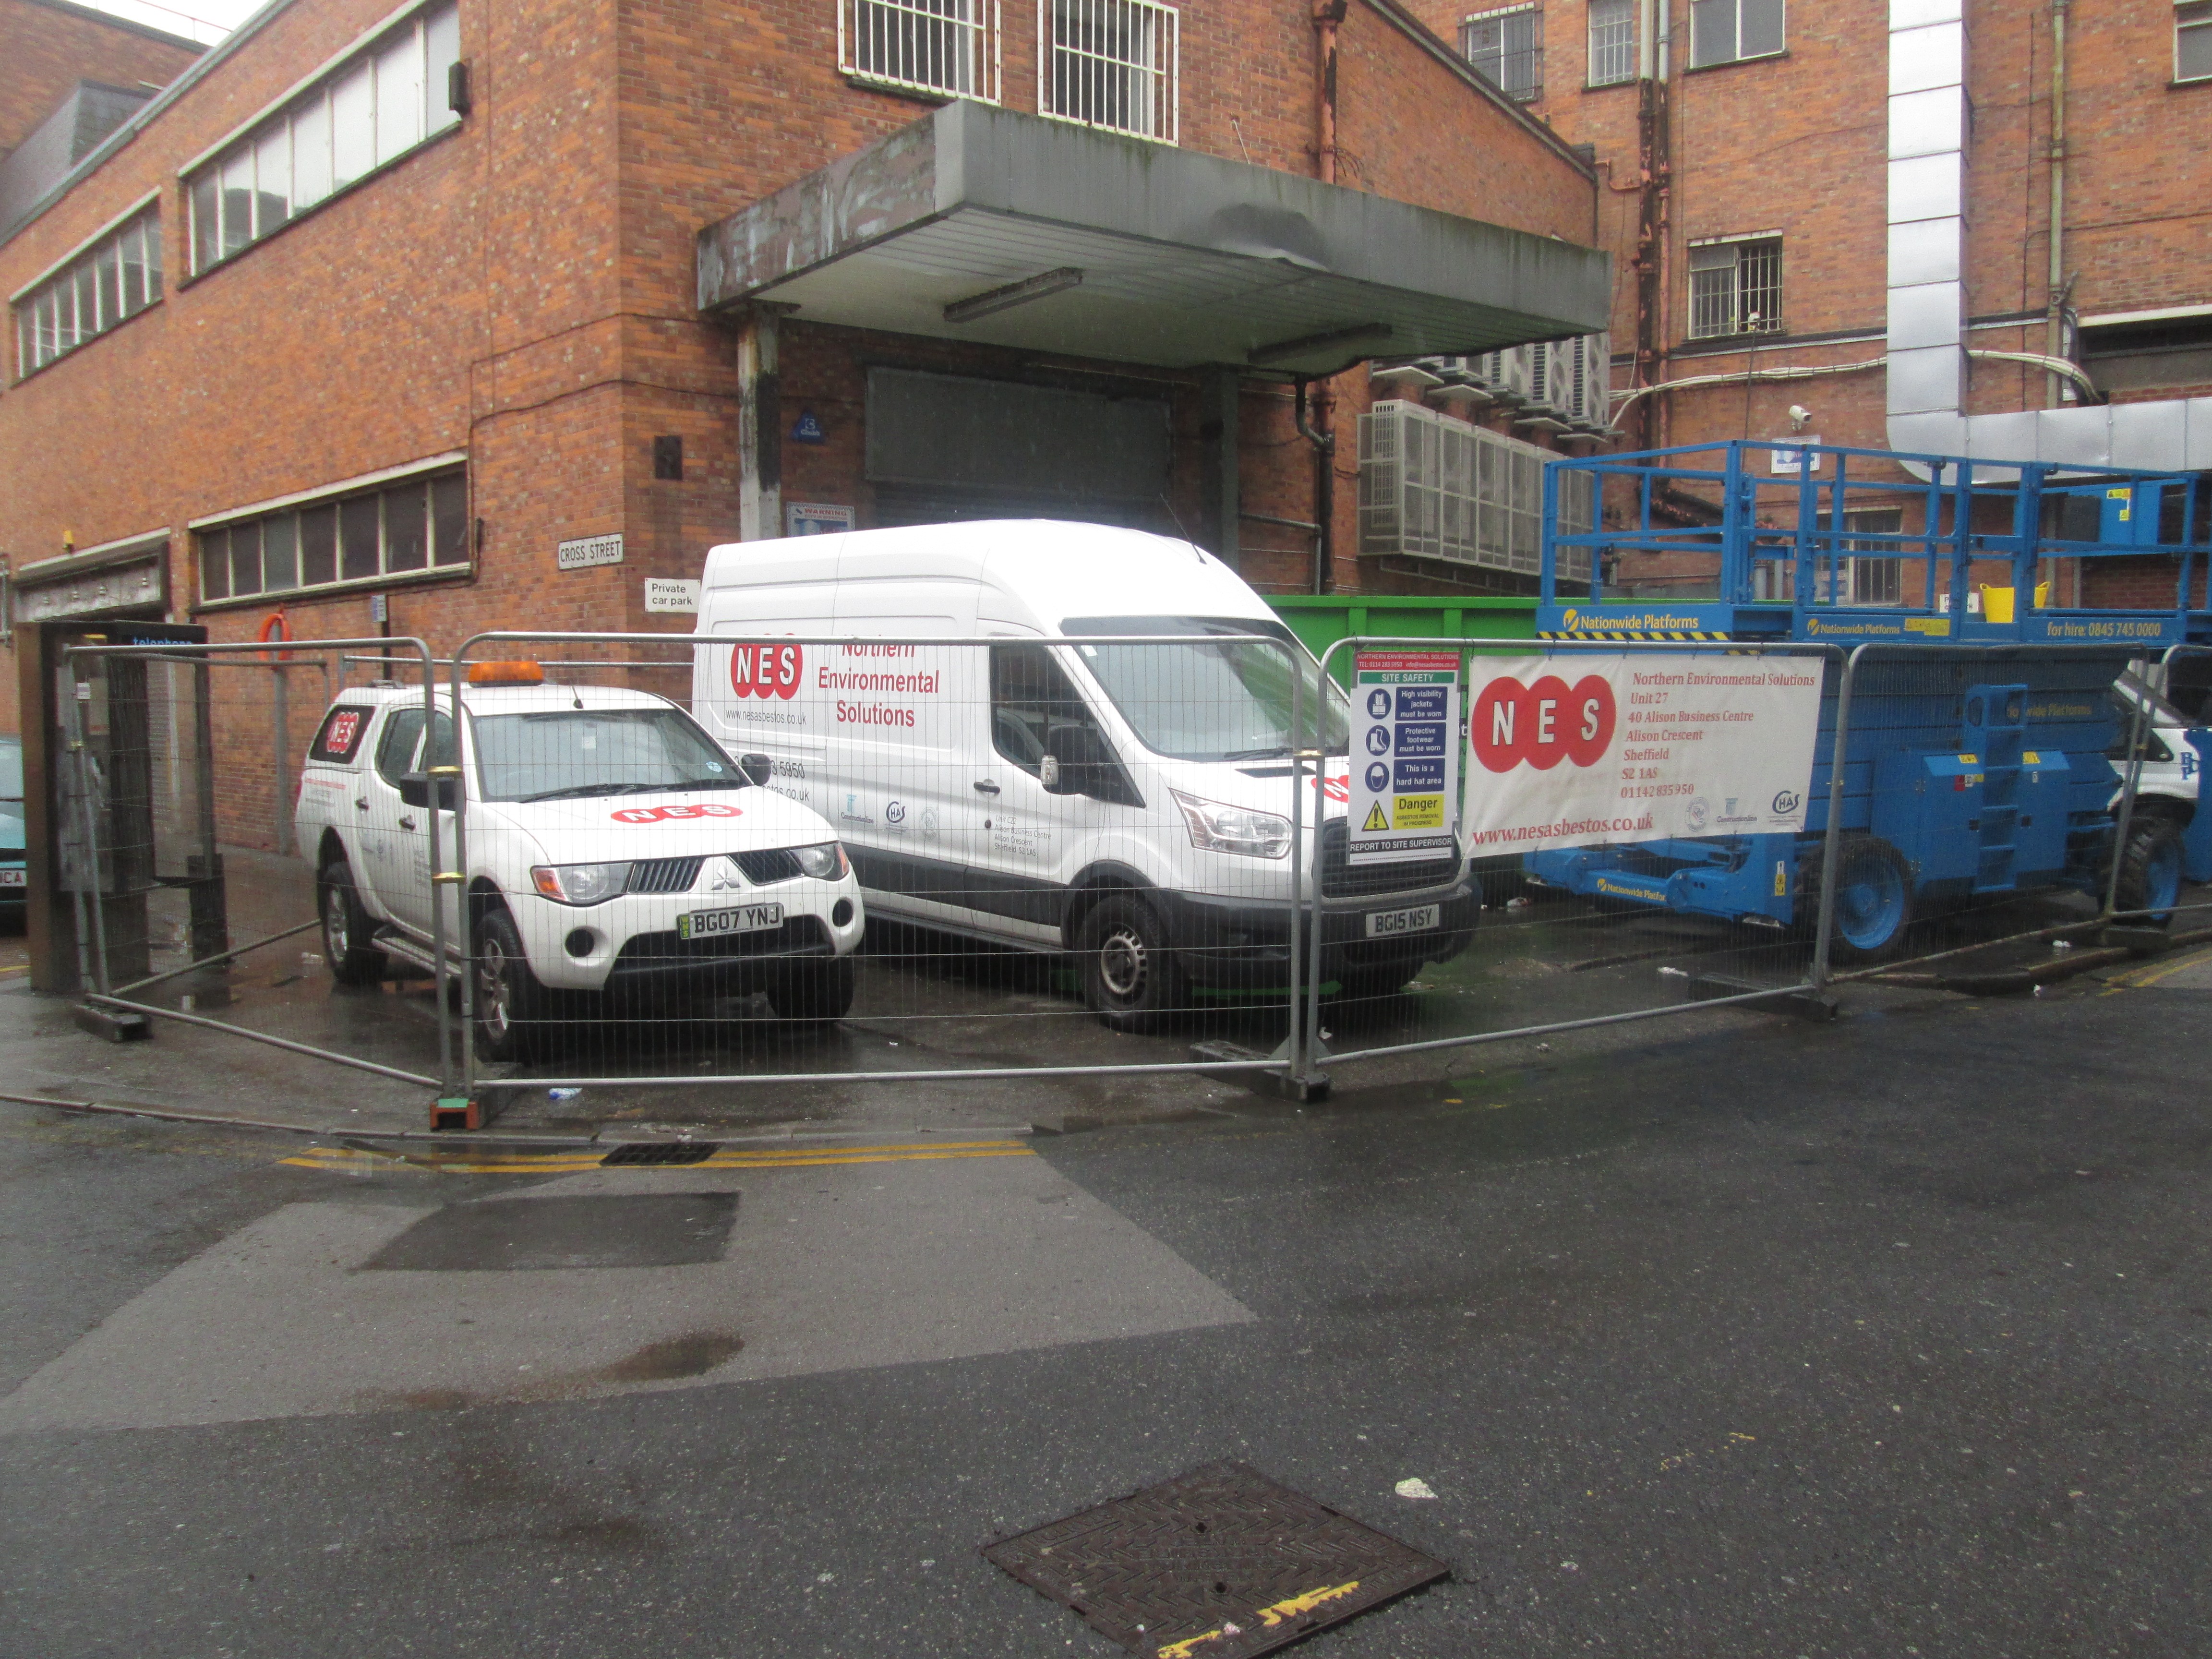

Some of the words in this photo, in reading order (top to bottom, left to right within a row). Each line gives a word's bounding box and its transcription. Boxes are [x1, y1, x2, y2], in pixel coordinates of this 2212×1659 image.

[560, 545, 585, 562] CROSS
[589, 541, 621, 559] STREET
[652, 583, 686, 593] Private
[671, 596, 693, 606] park
[1581, 614, 1642, 629] Nationwide
[1644, 614, 1699, 628] Platforms
[1821, 624, 1864, 634] Nationwide
[1865, 624, 1900, 634] Platforms
[2047, 622, 2062, 636] for
[2089, 623, 2114, 637] 0845
[2116, 623, 2135, 637] 745
[736, 646, 796, 686] NES
[818, 667, 939, 694] Environmental
[1382, 673, 1400, 682] SITE
[1403, 673, 1434, 682] SAFETY
[1633, 672, 1684, 685] Northern
[1686, 672, 1765, 685] Environmental
[1767, 673, 1815, 686] Solutions
[1401, 690, 1415, 698] High
[1417, 690, 1442, 698] visibility
[1630, 692, 1653, 704] Unit
[1655, 692, 1669, 704] 27
[1411, 700, 1432, 709] jackets
[726, 709, 807, 725] www.nesasbestos.co.uk
[837, 699, 915, 727] Solutions
[1628, 711, 1642, 723] 40
[1645, 711, 1675, 722] Alison
[1679, 710, 1720, 722] Business
[1722, 710, 1754, 721] Centre
[1491, 698, 1600, 746] NES
[1626, 730, 1659, 742] Alison
[1661, 730, 1704, 741] Crescent
[1623, 748, 1669, 761] Sheffield
[780, 761, 805, 779] 5950
[1622, 768, 1635, 779] S2
[1639, 767, 1659, 779] 1AS
[1399, 798, 1438, 811] Danger
[1772, 790, 1800, 814] CHAS
[622, 805, 733, 821] NES
[995, 824, 1010, 833] Alison
[1011, 827, 1033, 837] Business
[1034, 830, 1051, 840] Centre
[1472, 812, 1654, 845] www.nesasbestos.co.uk
[995, 834, 1010, 842] Alison
[1010, 836, 1033, 846] Crescent
[1350, 842, 1379, 852] REPORT
[1381, 841, 1391, 849] TO
[1392, 840, 1407, 849] SITE
[1409, 837, 1452, 847] SUPERVISOR
[995, 842, 1016, 853] Sheffield
[1026, 848, 1036, 856] 1AS
[1608, 884, 1643, 897] Nationwide
[1644, 890, 1666, 901] Platfor
[695, 911, 740, 933] BG07
[746, 906, 780, 927] YNJ
[1375, 913, 1406, 933] BG15
[1409, 908, 1432, 928] NSY
